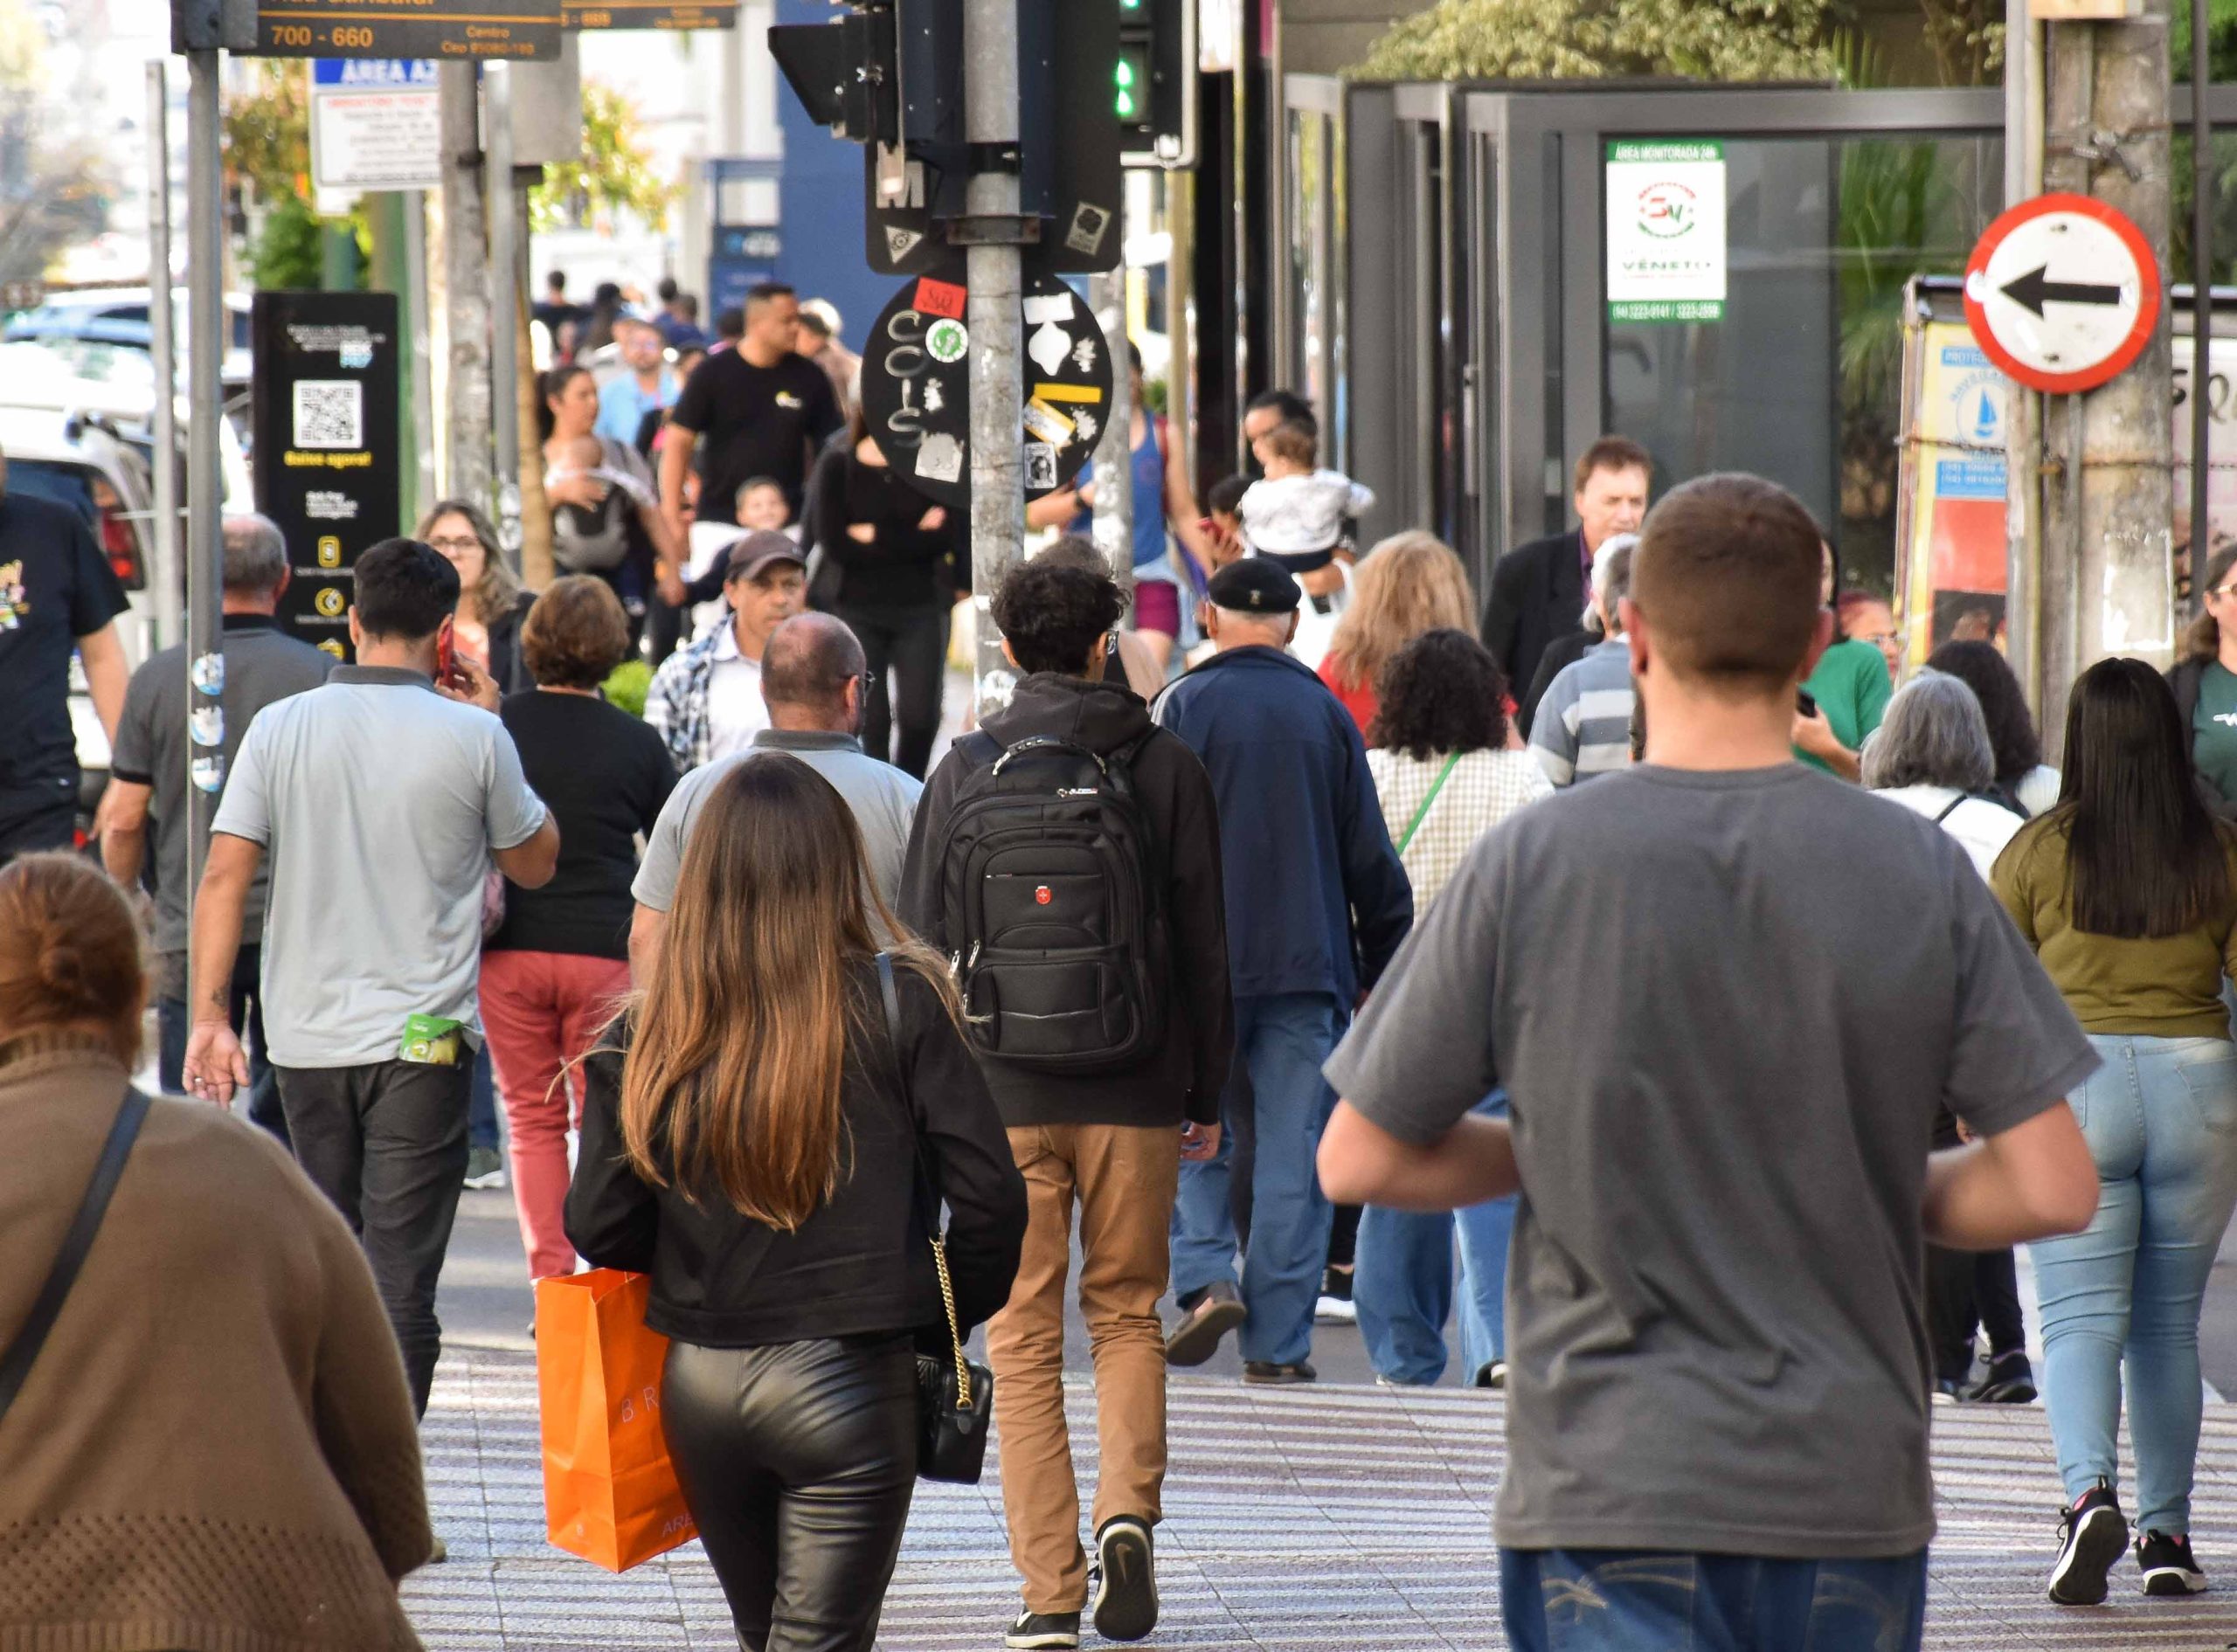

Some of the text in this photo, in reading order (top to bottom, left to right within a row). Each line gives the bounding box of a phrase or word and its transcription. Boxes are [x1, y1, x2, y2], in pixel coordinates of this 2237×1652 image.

[271, 25, 312, 46] 700
[332, 26, 373, 47] 660
[1641, 145, 1699, 159] MONITORADA
